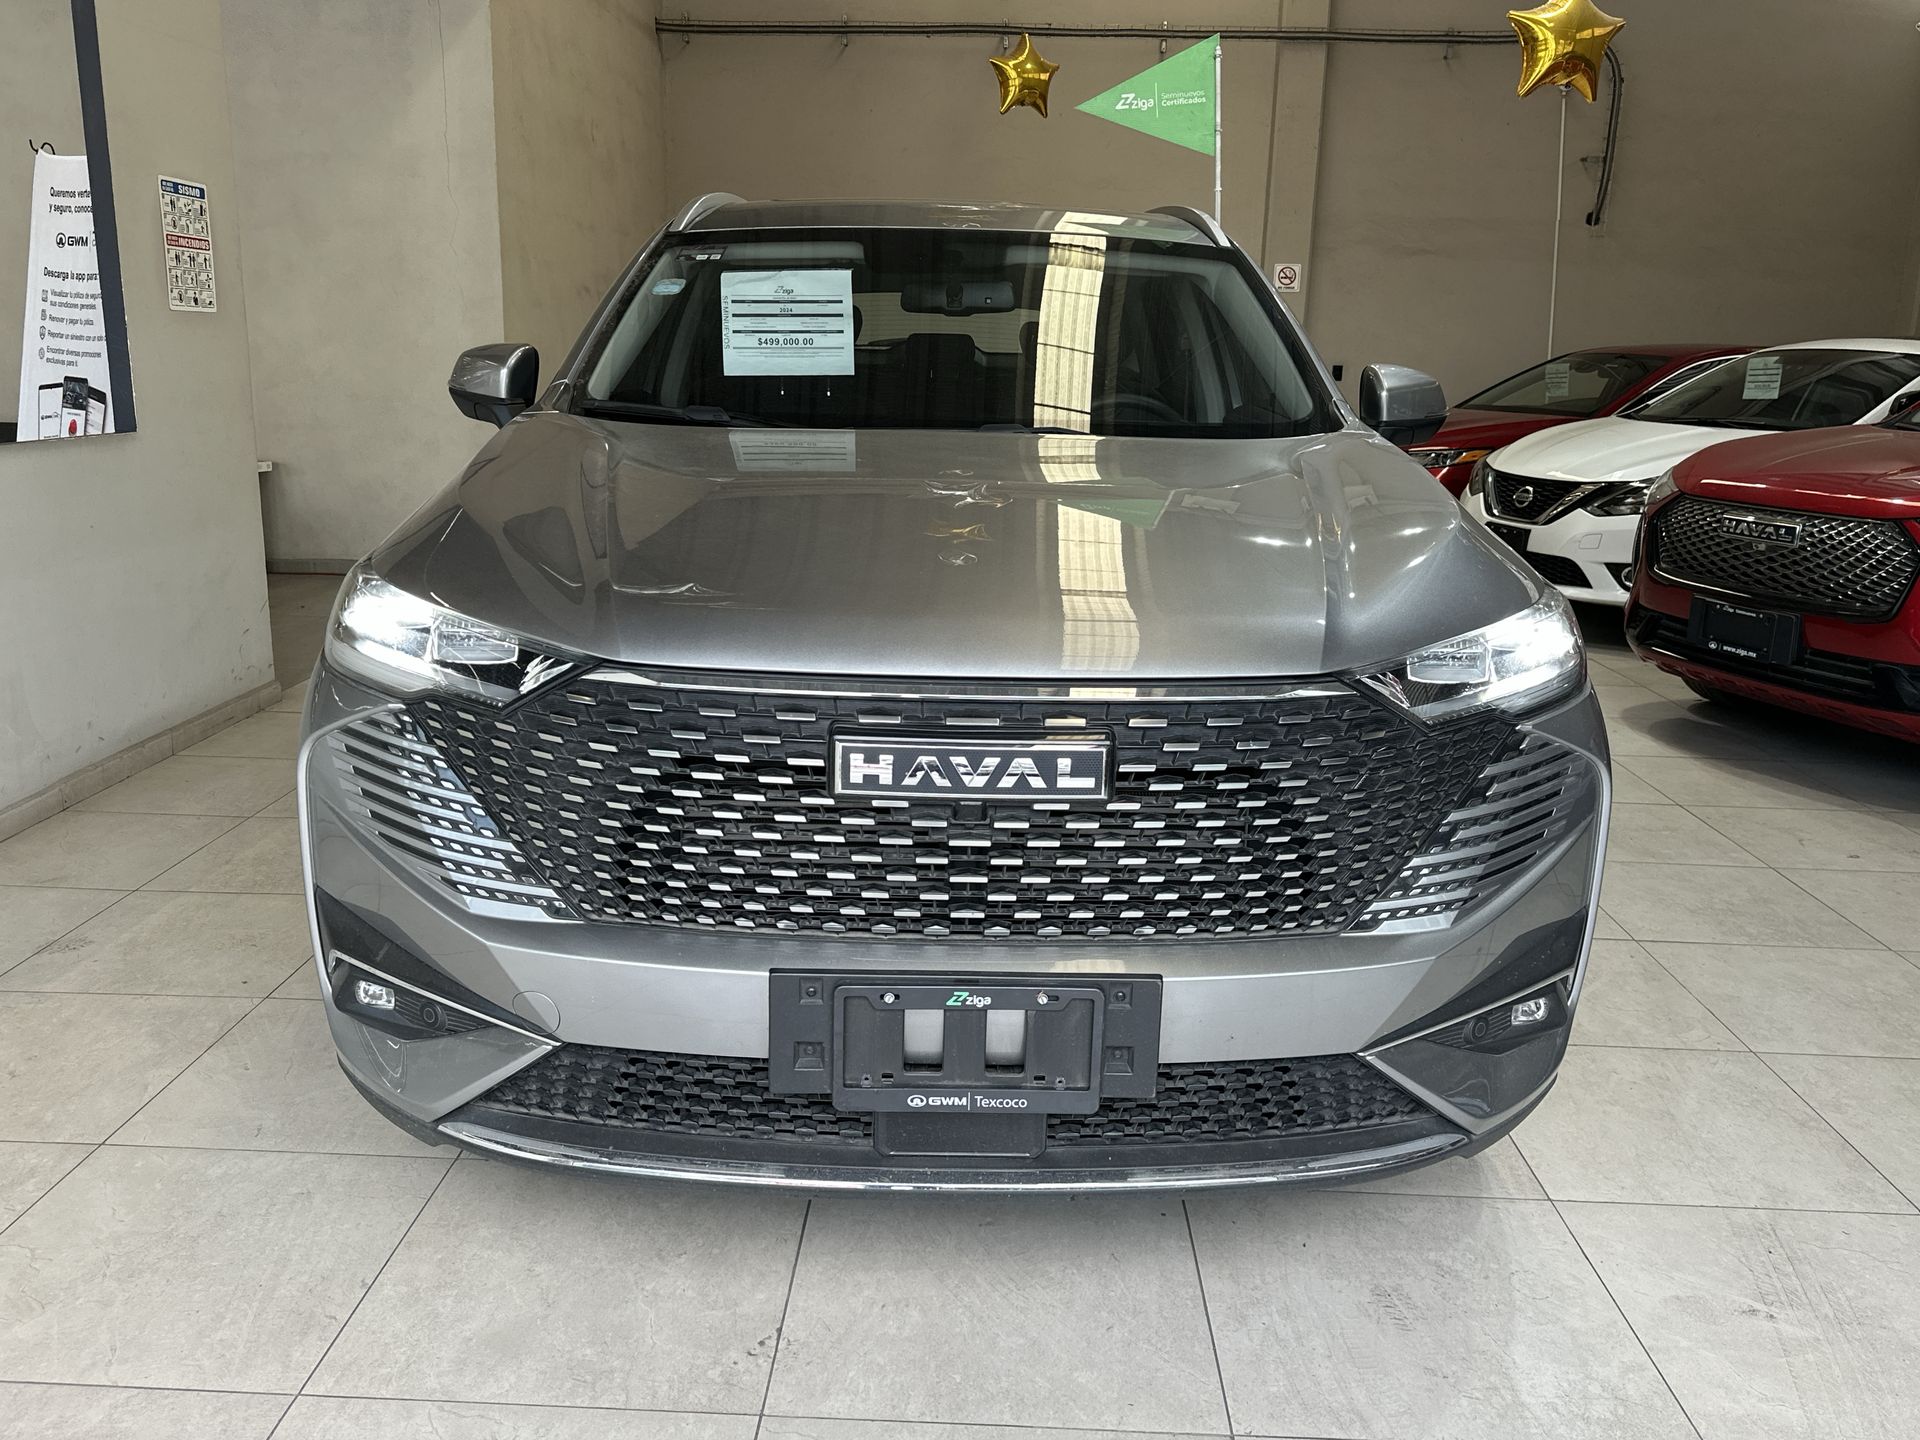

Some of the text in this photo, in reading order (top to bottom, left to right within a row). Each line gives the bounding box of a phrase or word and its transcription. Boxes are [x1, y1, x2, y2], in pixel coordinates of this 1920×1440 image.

[1161, 90, 1205, 100] Seminuevos
[1161, 97, 1207, 107] Certificados
[50, 186, 76, 198] Queremos
[178, 184, 200, 198] SISMO
[48, 203, 53, 213] y
[67, 236, 89, 246] GWM
[43, 266, 69, 281] Descarga
[70, 270, 75, 280] la
[75, 272, 86, 282] app
[722, 295, 730, 350] SEMINUEVOS
[757, 337, 814, 347] $499,000.00
[1722, 519, 1793, 542] HAVAL
[849, 753, 1096, 789] HAVAL
[928, 1095, 1028, 1108] GWM Texcoco
